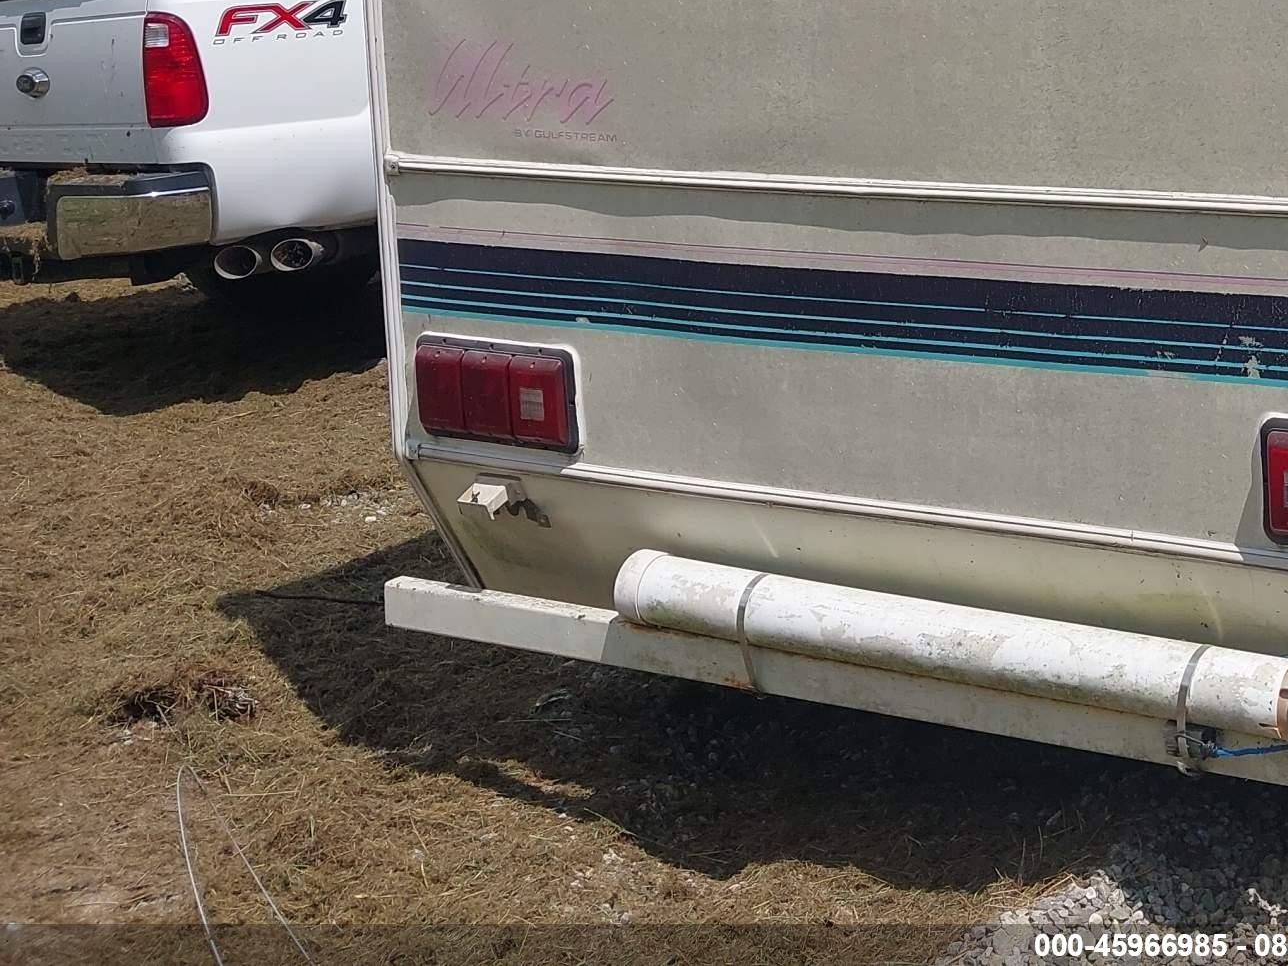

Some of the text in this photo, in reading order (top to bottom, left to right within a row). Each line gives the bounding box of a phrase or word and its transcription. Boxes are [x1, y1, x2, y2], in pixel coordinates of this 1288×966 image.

[213, 29, 344, 45] OFF ROAD
[515, 128, 618, 143] BY GULFSTREAM
